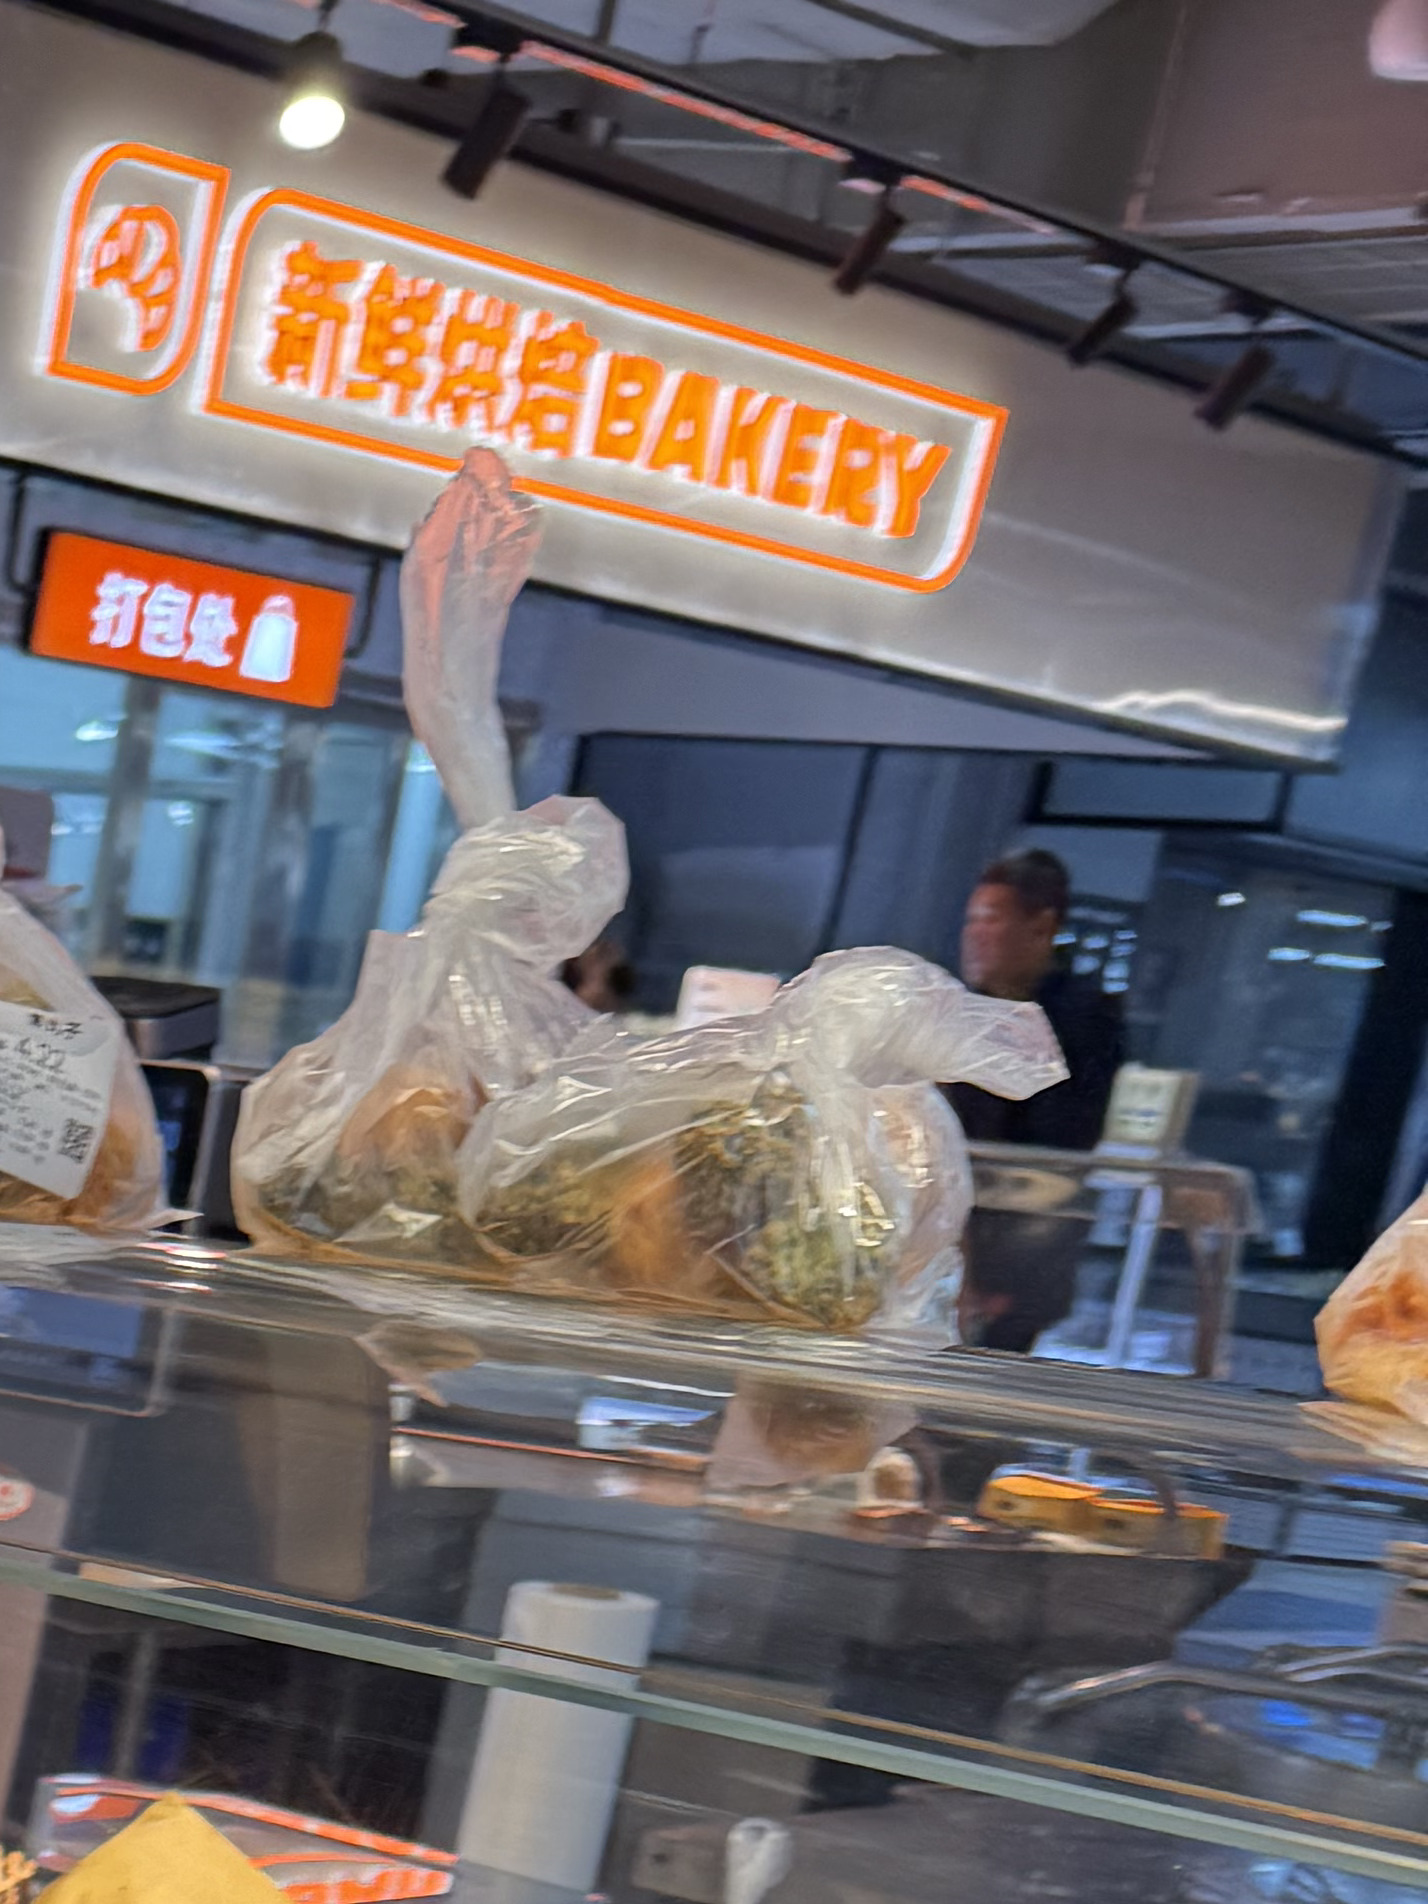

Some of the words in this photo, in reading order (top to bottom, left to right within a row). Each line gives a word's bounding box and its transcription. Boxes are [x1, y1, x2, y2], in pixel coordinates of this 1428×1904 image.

[266, 240, 600, 460] 新鲜烘焙
[592, 350, 954, 540] BAKERY
